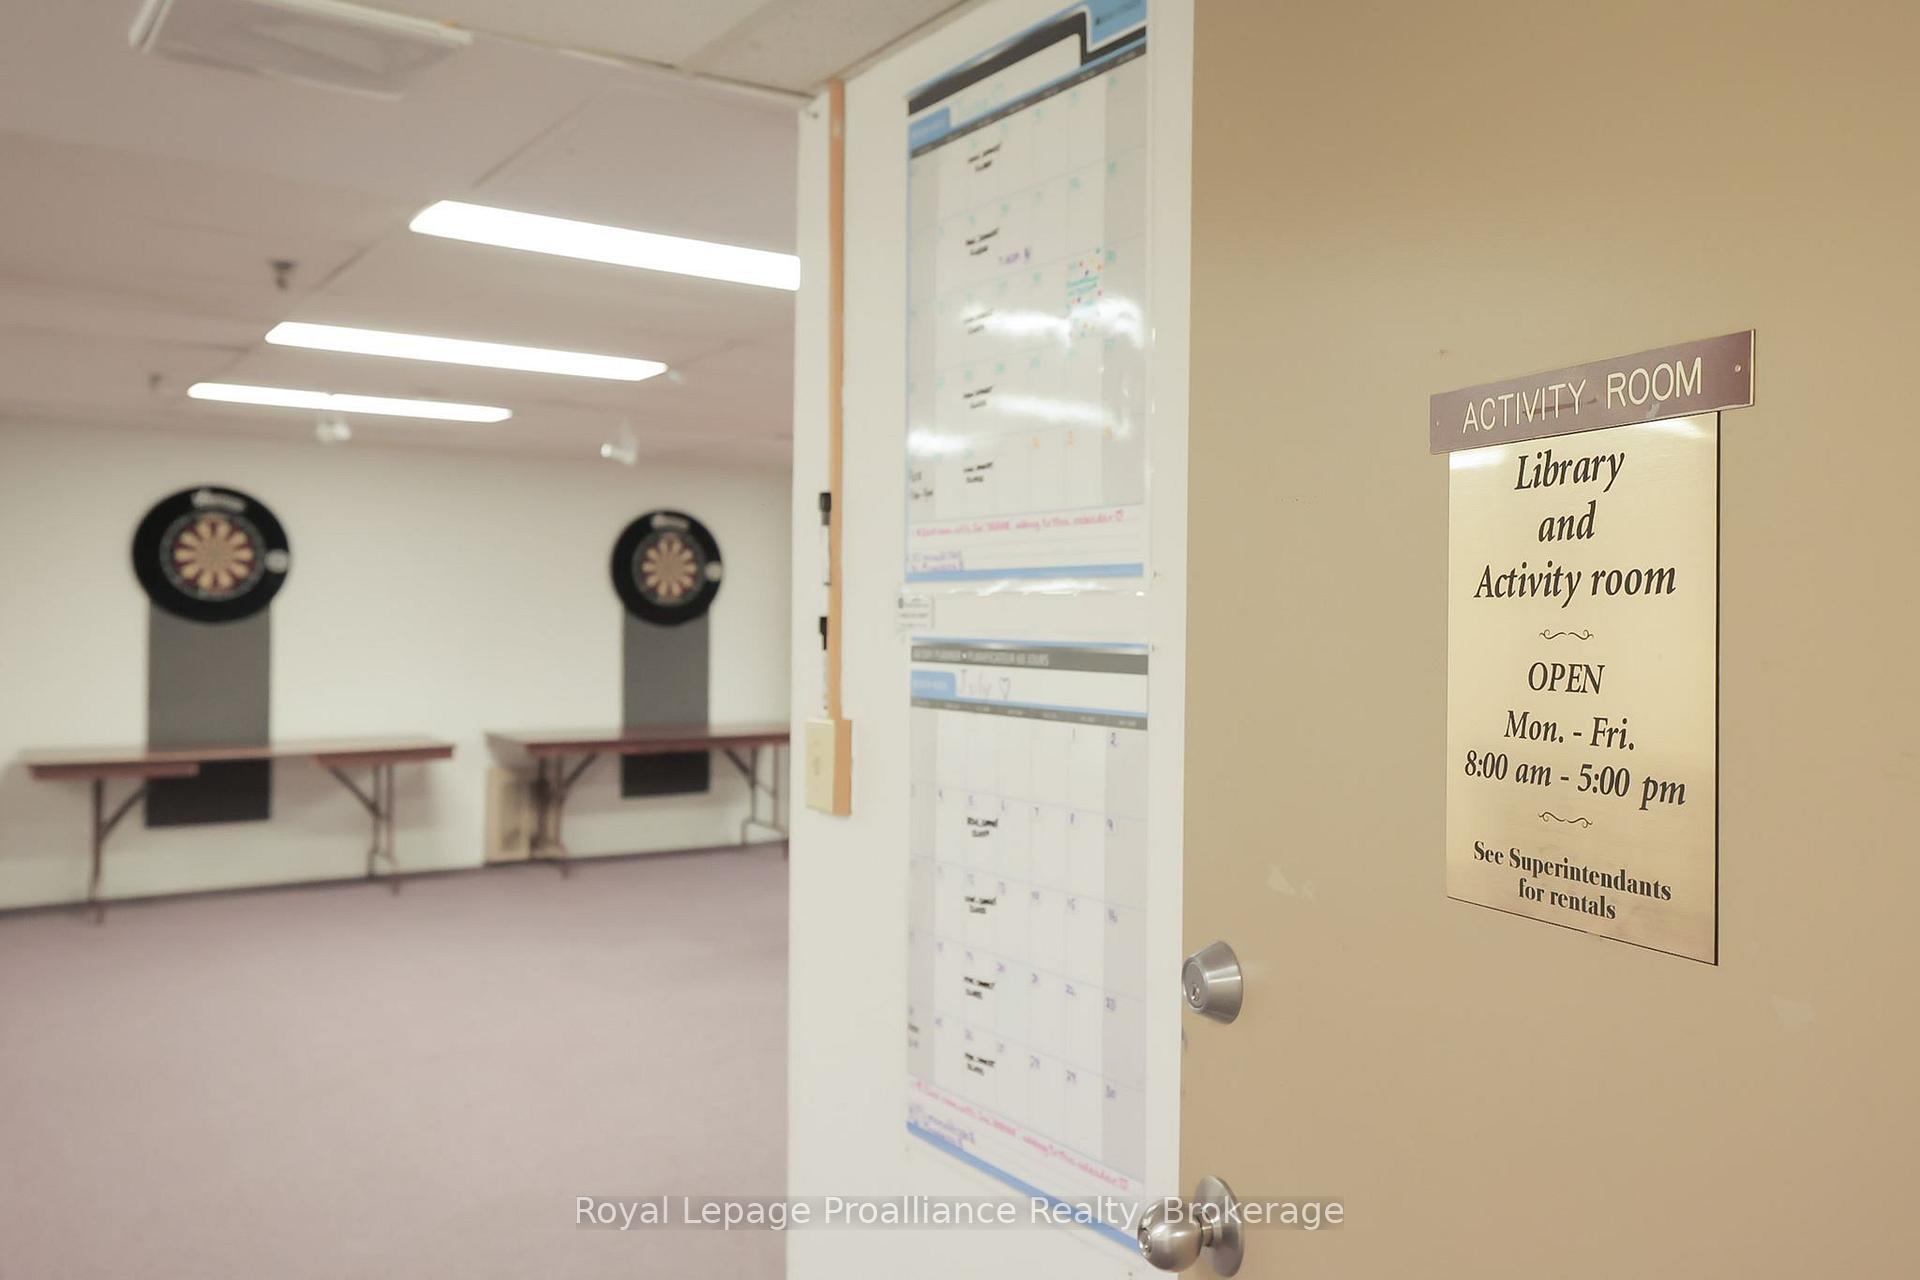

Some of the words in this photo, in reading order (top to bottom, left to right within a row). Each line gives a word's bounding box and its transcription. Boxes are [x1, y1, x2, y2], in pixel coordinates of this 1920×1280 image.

[1462, 379, 1587, 434] ACTIVITY
[1607, 356, 1702, 410] ROOM
[1514, 449, 1625, 493] Library
[1538, 500, 1597, 543] and
[1473, 560, 1582, 609] Activity
[1590, 565, 1677, 596] room
[1527, 661, 1606, 695] OPEN
[1503, 710, 1565, 744] Mon.
[1590, 716, 1635, 751] Fri.
[1464, 750, 1509, 781] 8:00
[1515, 762, 1552, 786] am
[1576, 763, 1631, 797] 5:00
[1638, 775, 1686, 811] pm
[1473, 840, 1504, 866] See
[1508, 847, 1672, 901] Superintendants
[1518, 878, 1545, 902] for
[1550, 892, 1617, 920] rentals
